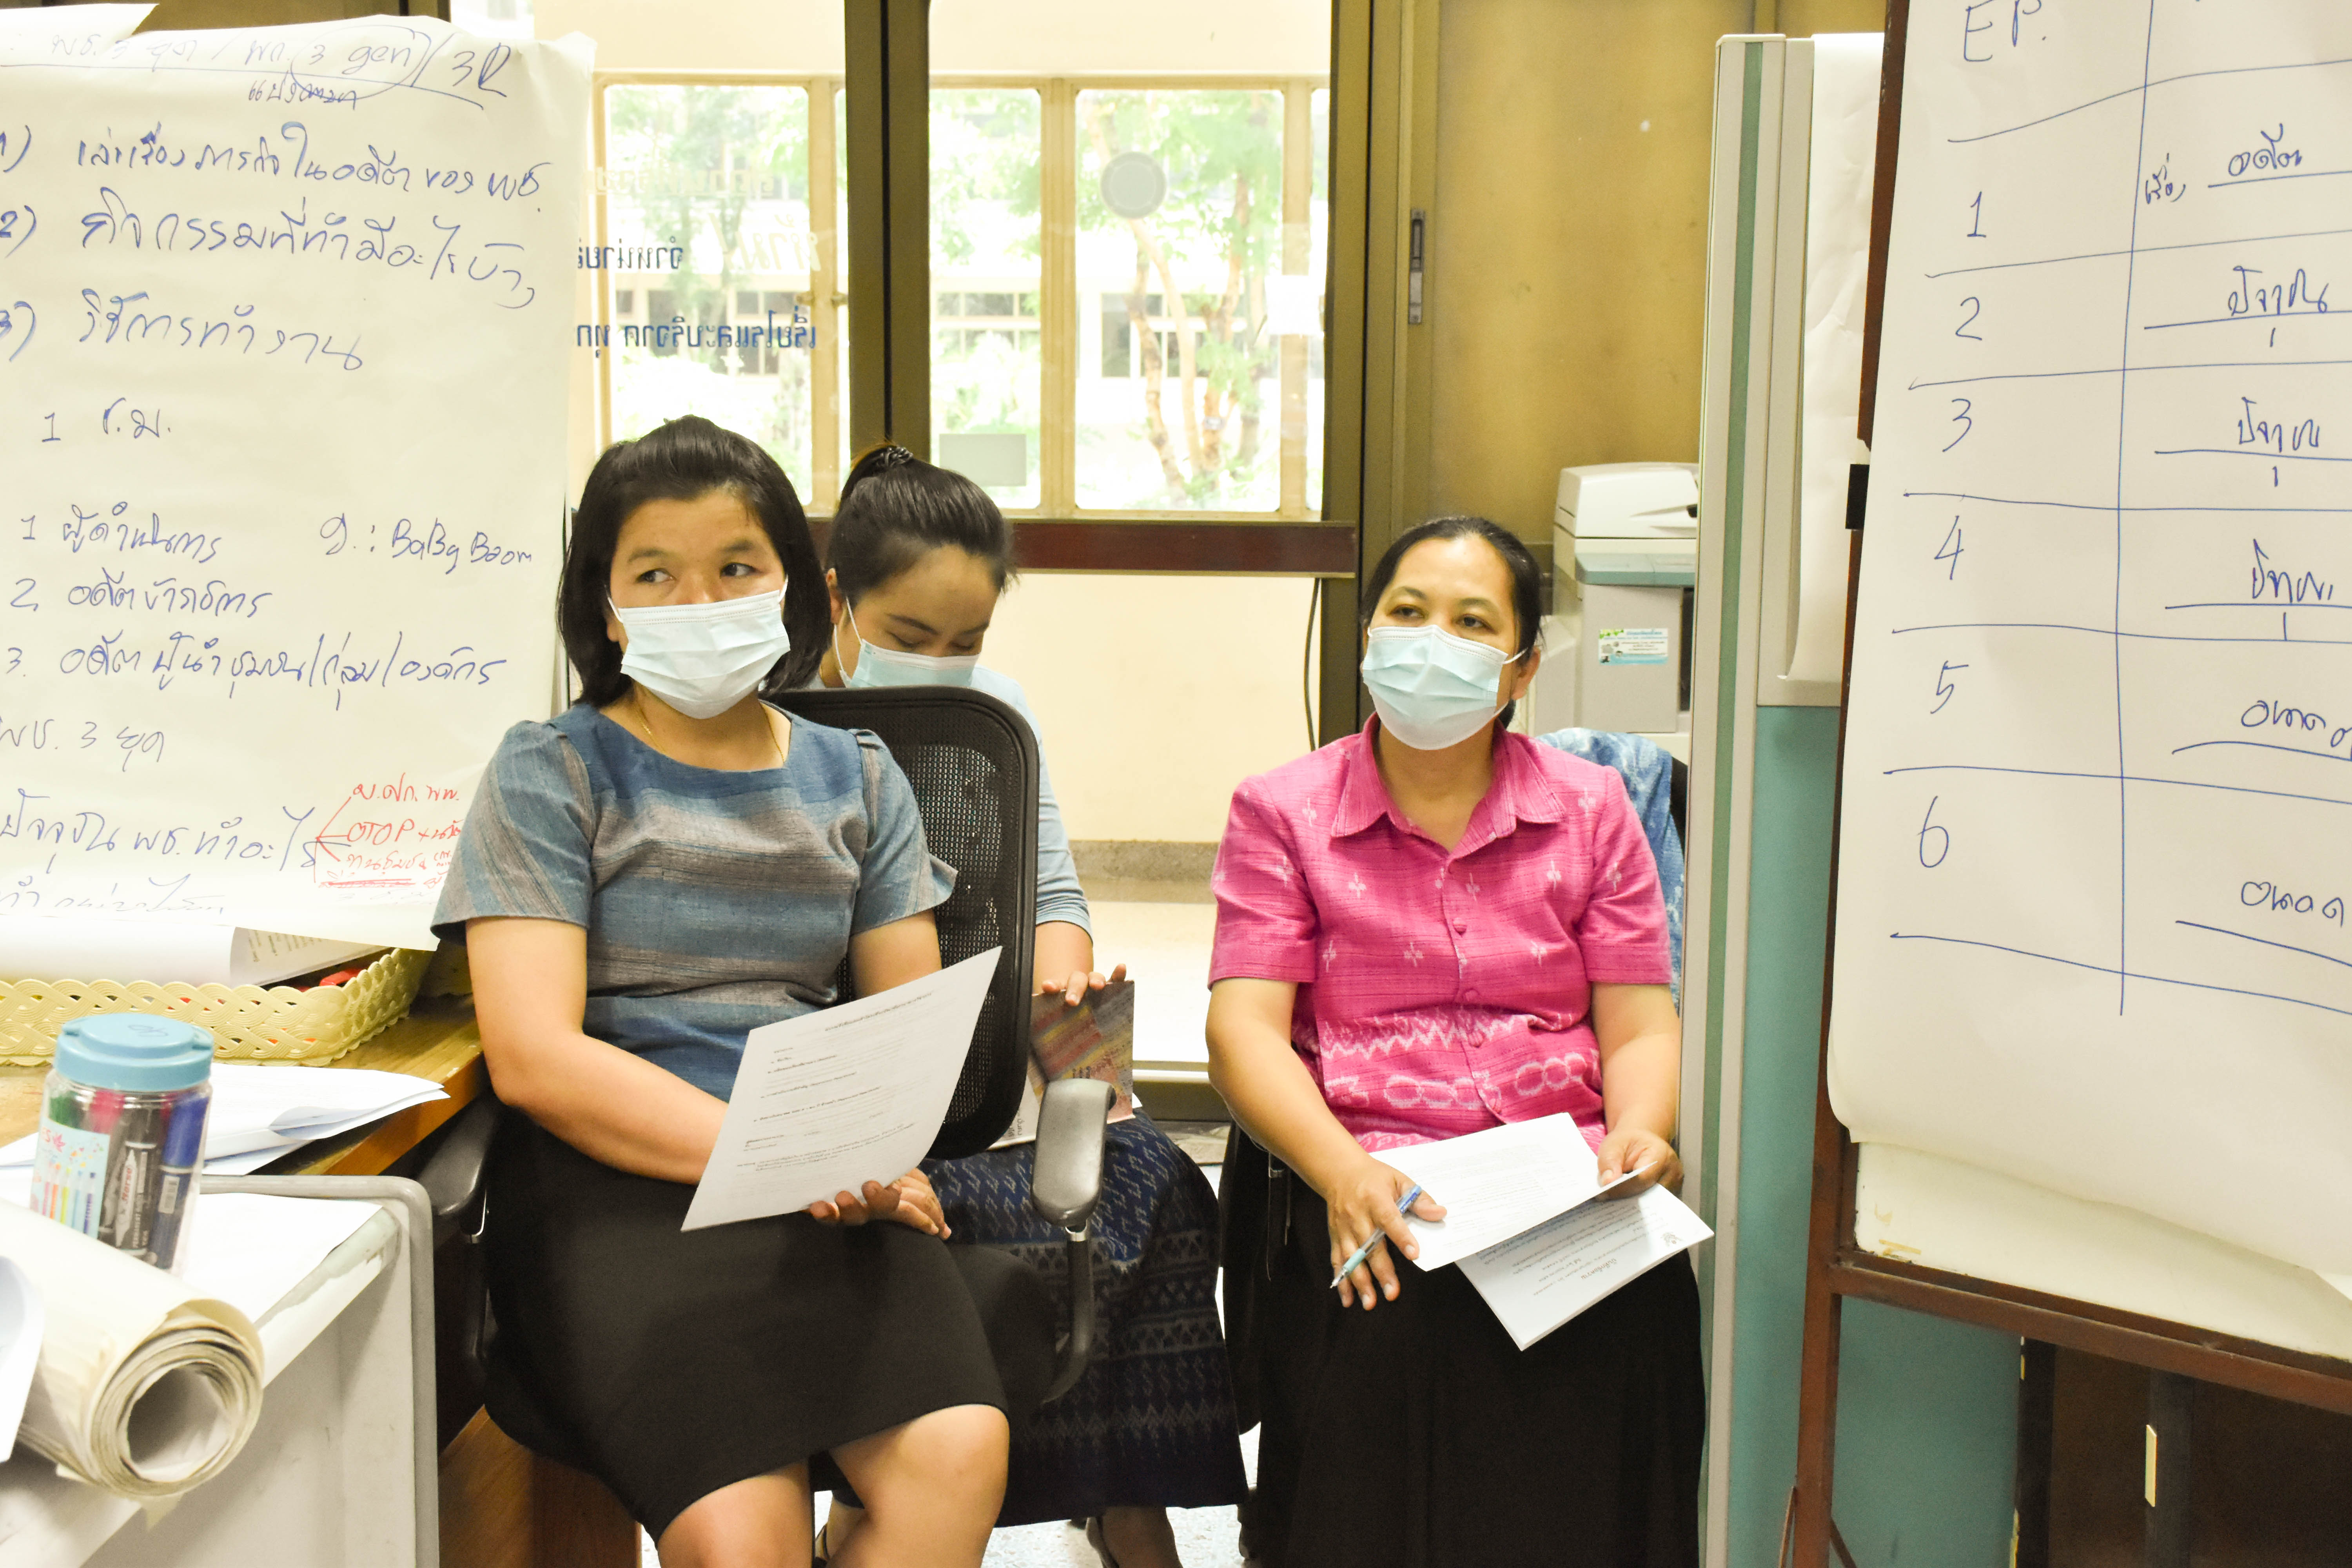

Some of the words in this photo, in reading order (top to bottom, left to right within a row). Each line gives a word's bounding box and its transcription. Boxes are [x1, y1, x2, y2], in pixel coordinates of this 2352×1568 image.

[308, 44, 326, 65] 3
[341, 44, 412, 75] gen
[1966, 191, 1987, 238] 1
[1955, 296, 1983, 341] 2
[42, 412, 61, 442] 1
[1942, 398, 1973, 452] 3
[21, 515, 36, 540] 1
[1933, 515, 1965, 580] 4
[1930, 660, 1969, 714] 5
[80, 720, 98, 750] 3
[1918, 795, 1950, 868] 6
